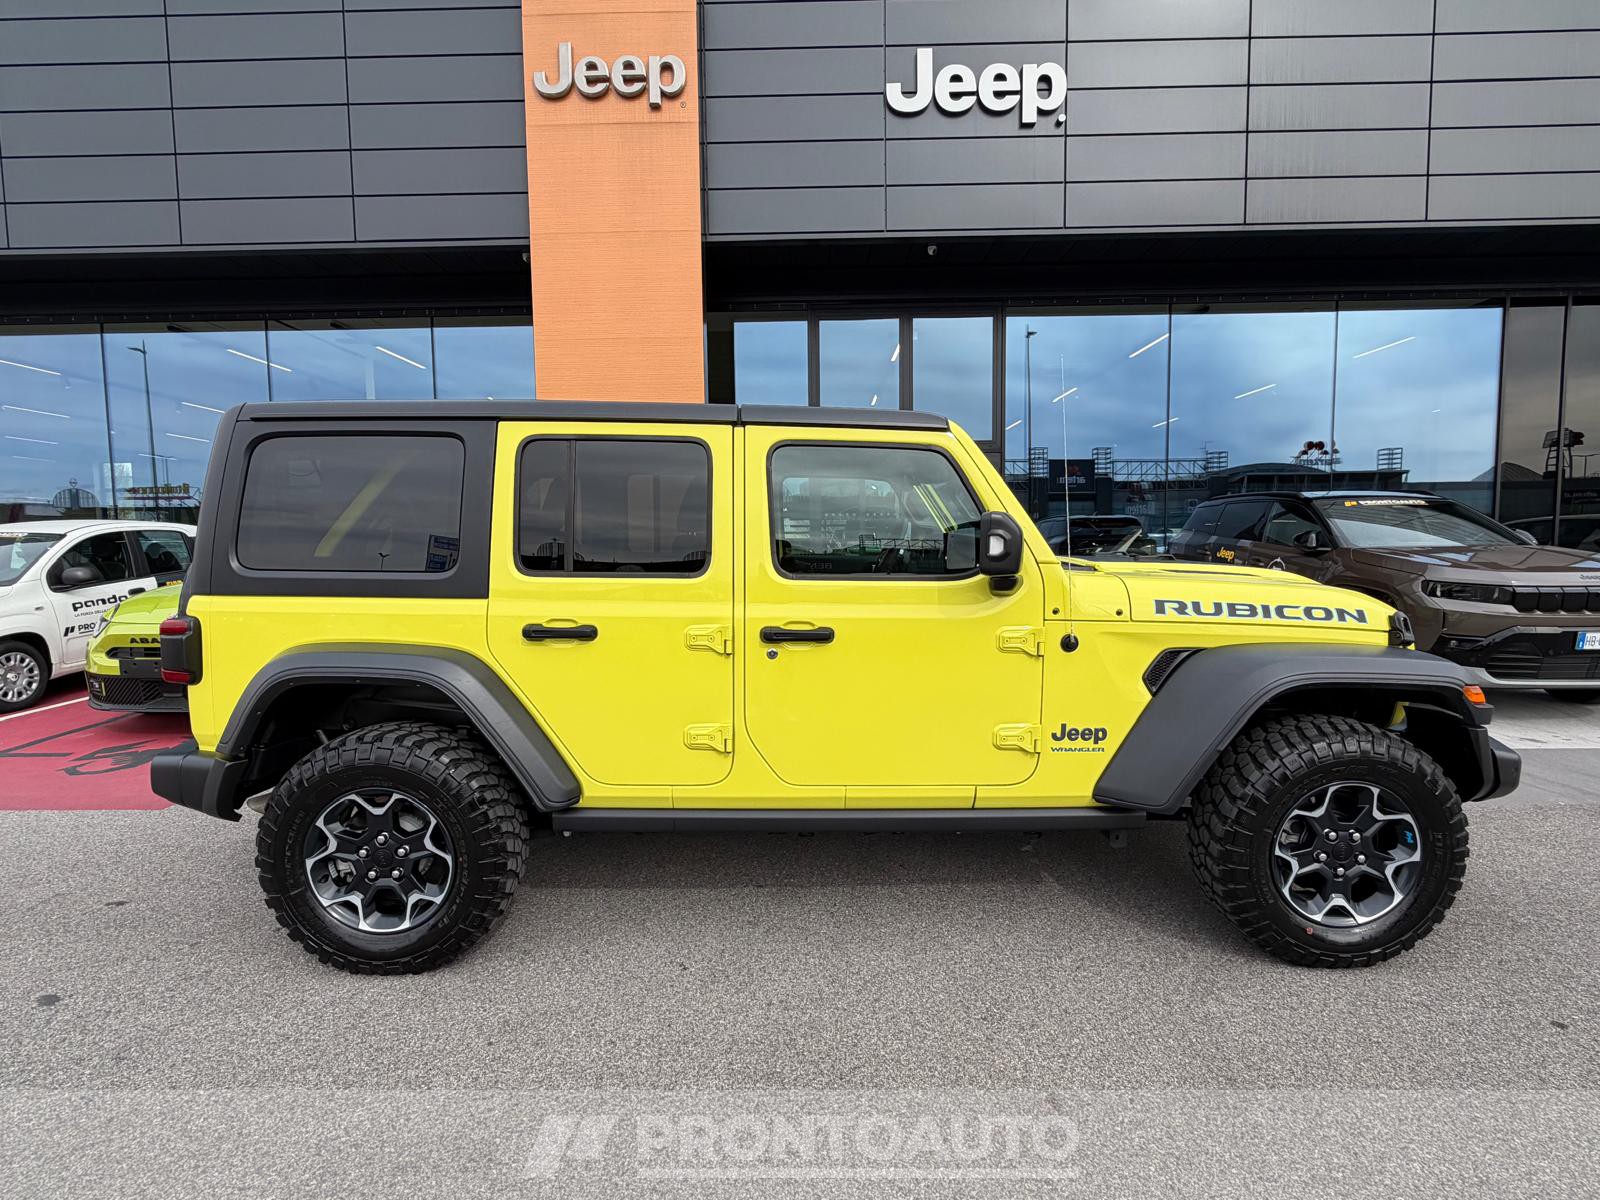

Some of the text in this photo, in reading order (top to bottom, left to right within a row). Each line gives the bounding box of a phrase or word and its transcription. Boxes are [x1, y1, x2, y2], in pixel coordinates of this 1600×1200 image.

[533, 42, 687, 109] Jeep
[886, 48, 1068, 125] Jeep
[1216, 547, 1235, 562] Jeep
[1154, 599, 1368, 624] RUBICON
[78, 622, 97, 632] PRO
[1051, 723, 1108, 745] Jeep
